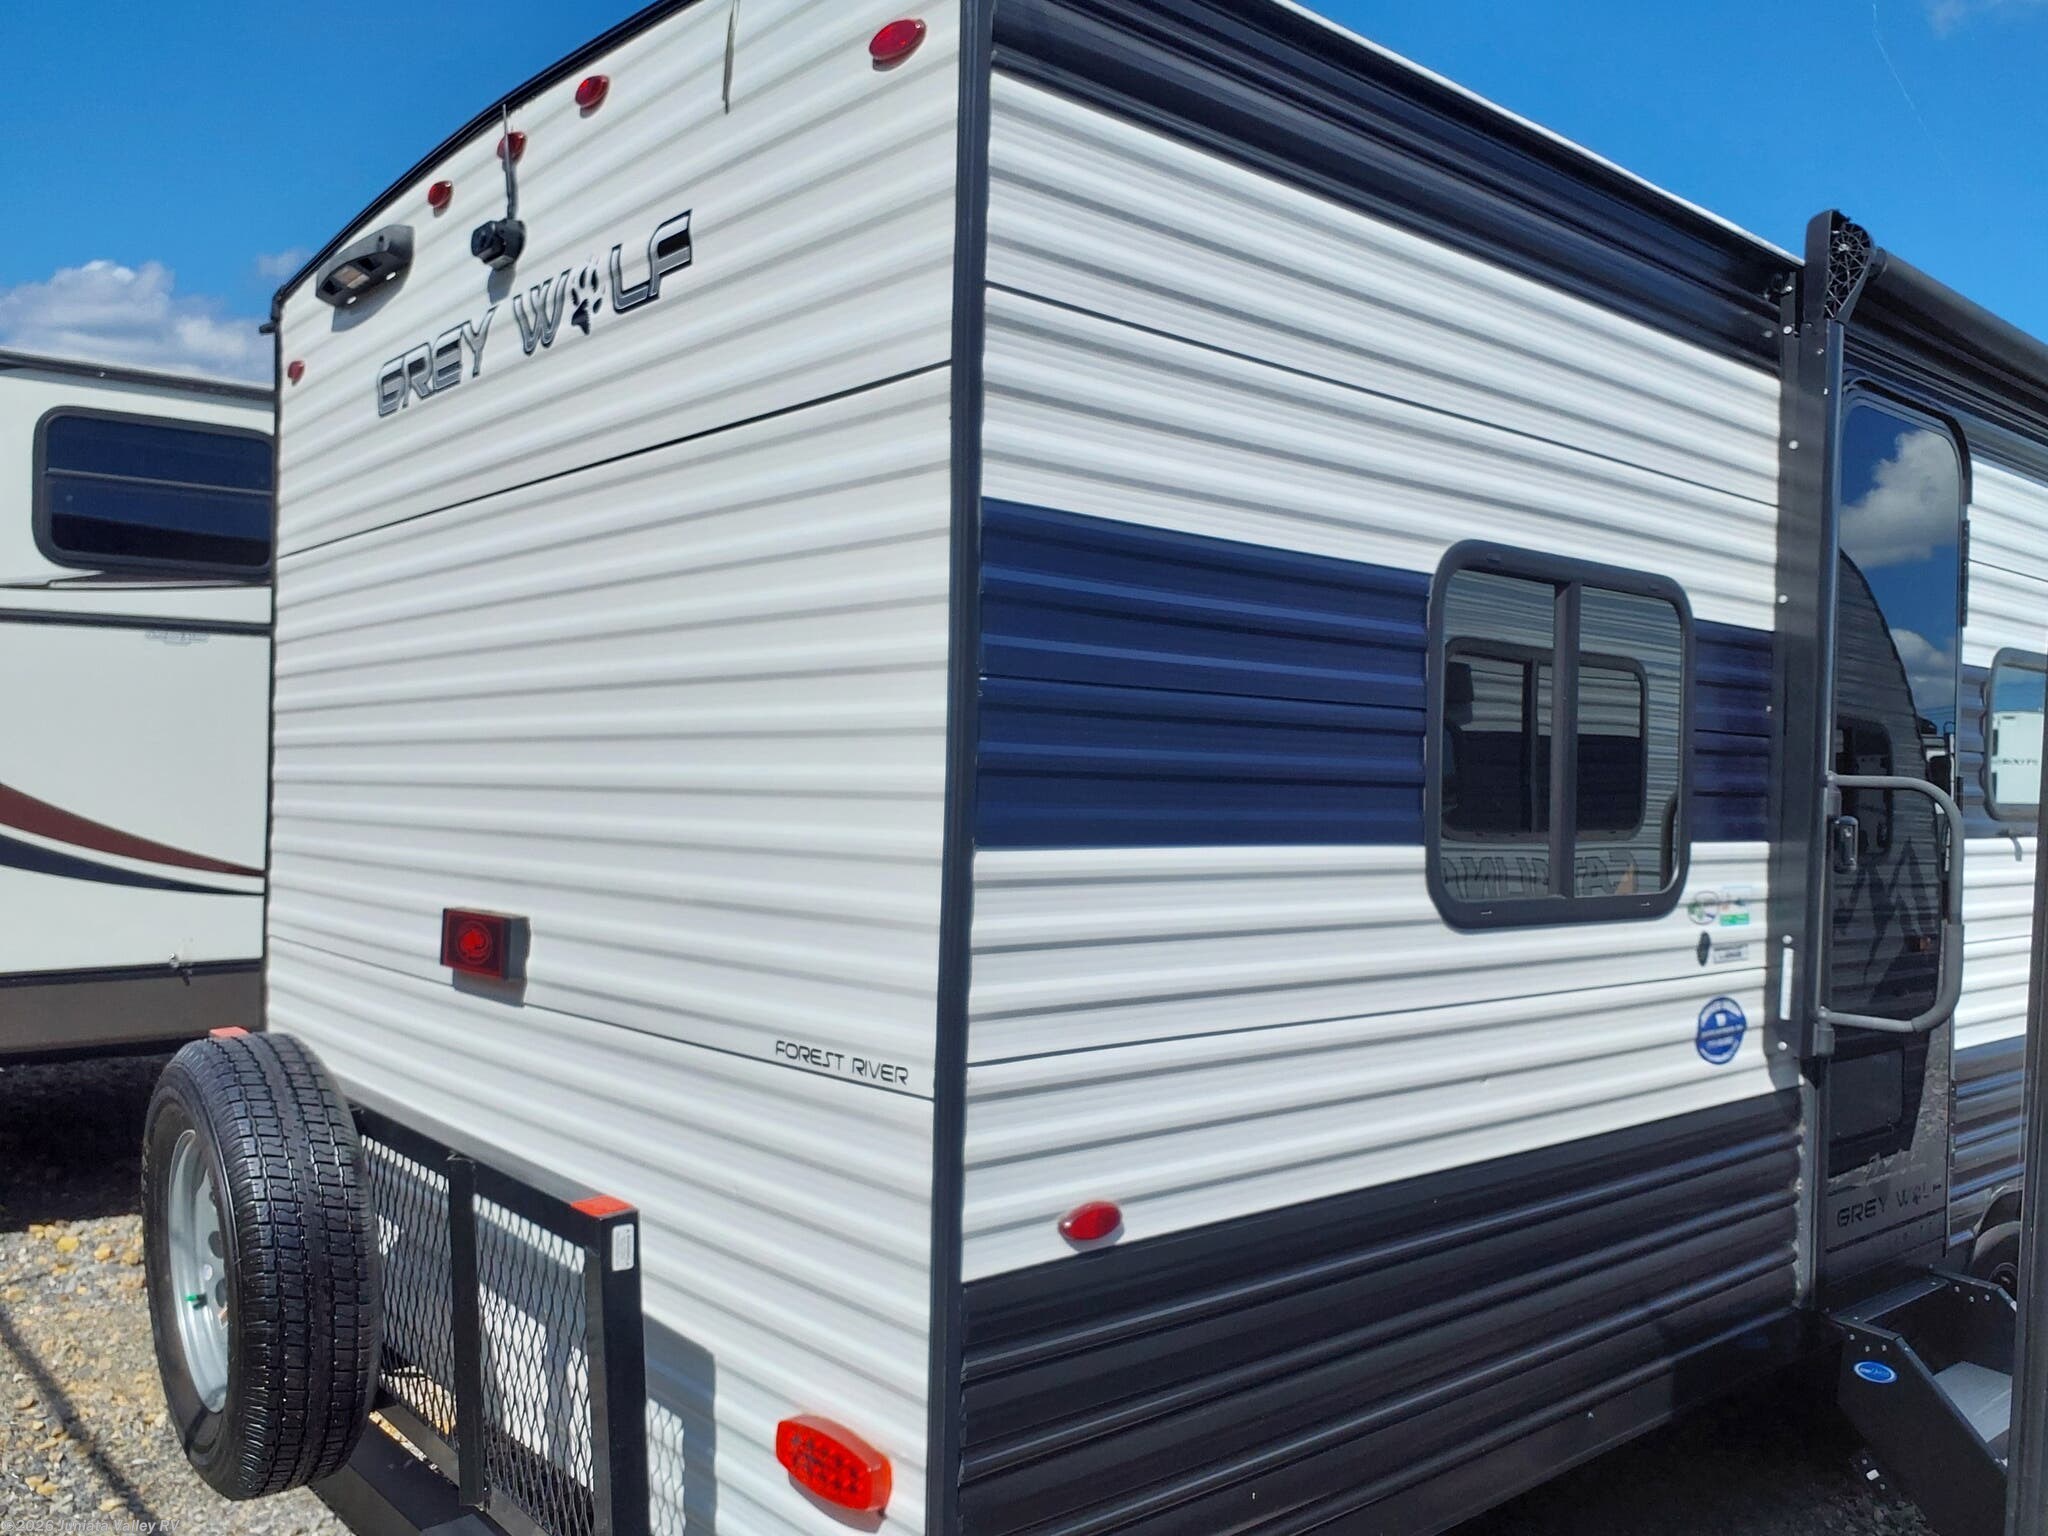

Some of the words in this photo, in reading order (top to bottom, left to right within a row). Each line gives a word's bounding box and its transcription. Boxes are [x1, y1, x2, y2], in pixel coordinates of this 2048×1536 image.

[376, 305, 498, 417] GREY
[775, 1040, 845, 1071] FOREST
[852, 1057, 909, 1086] RIVER
[1837, 1195, 1888, 1228] GREY
